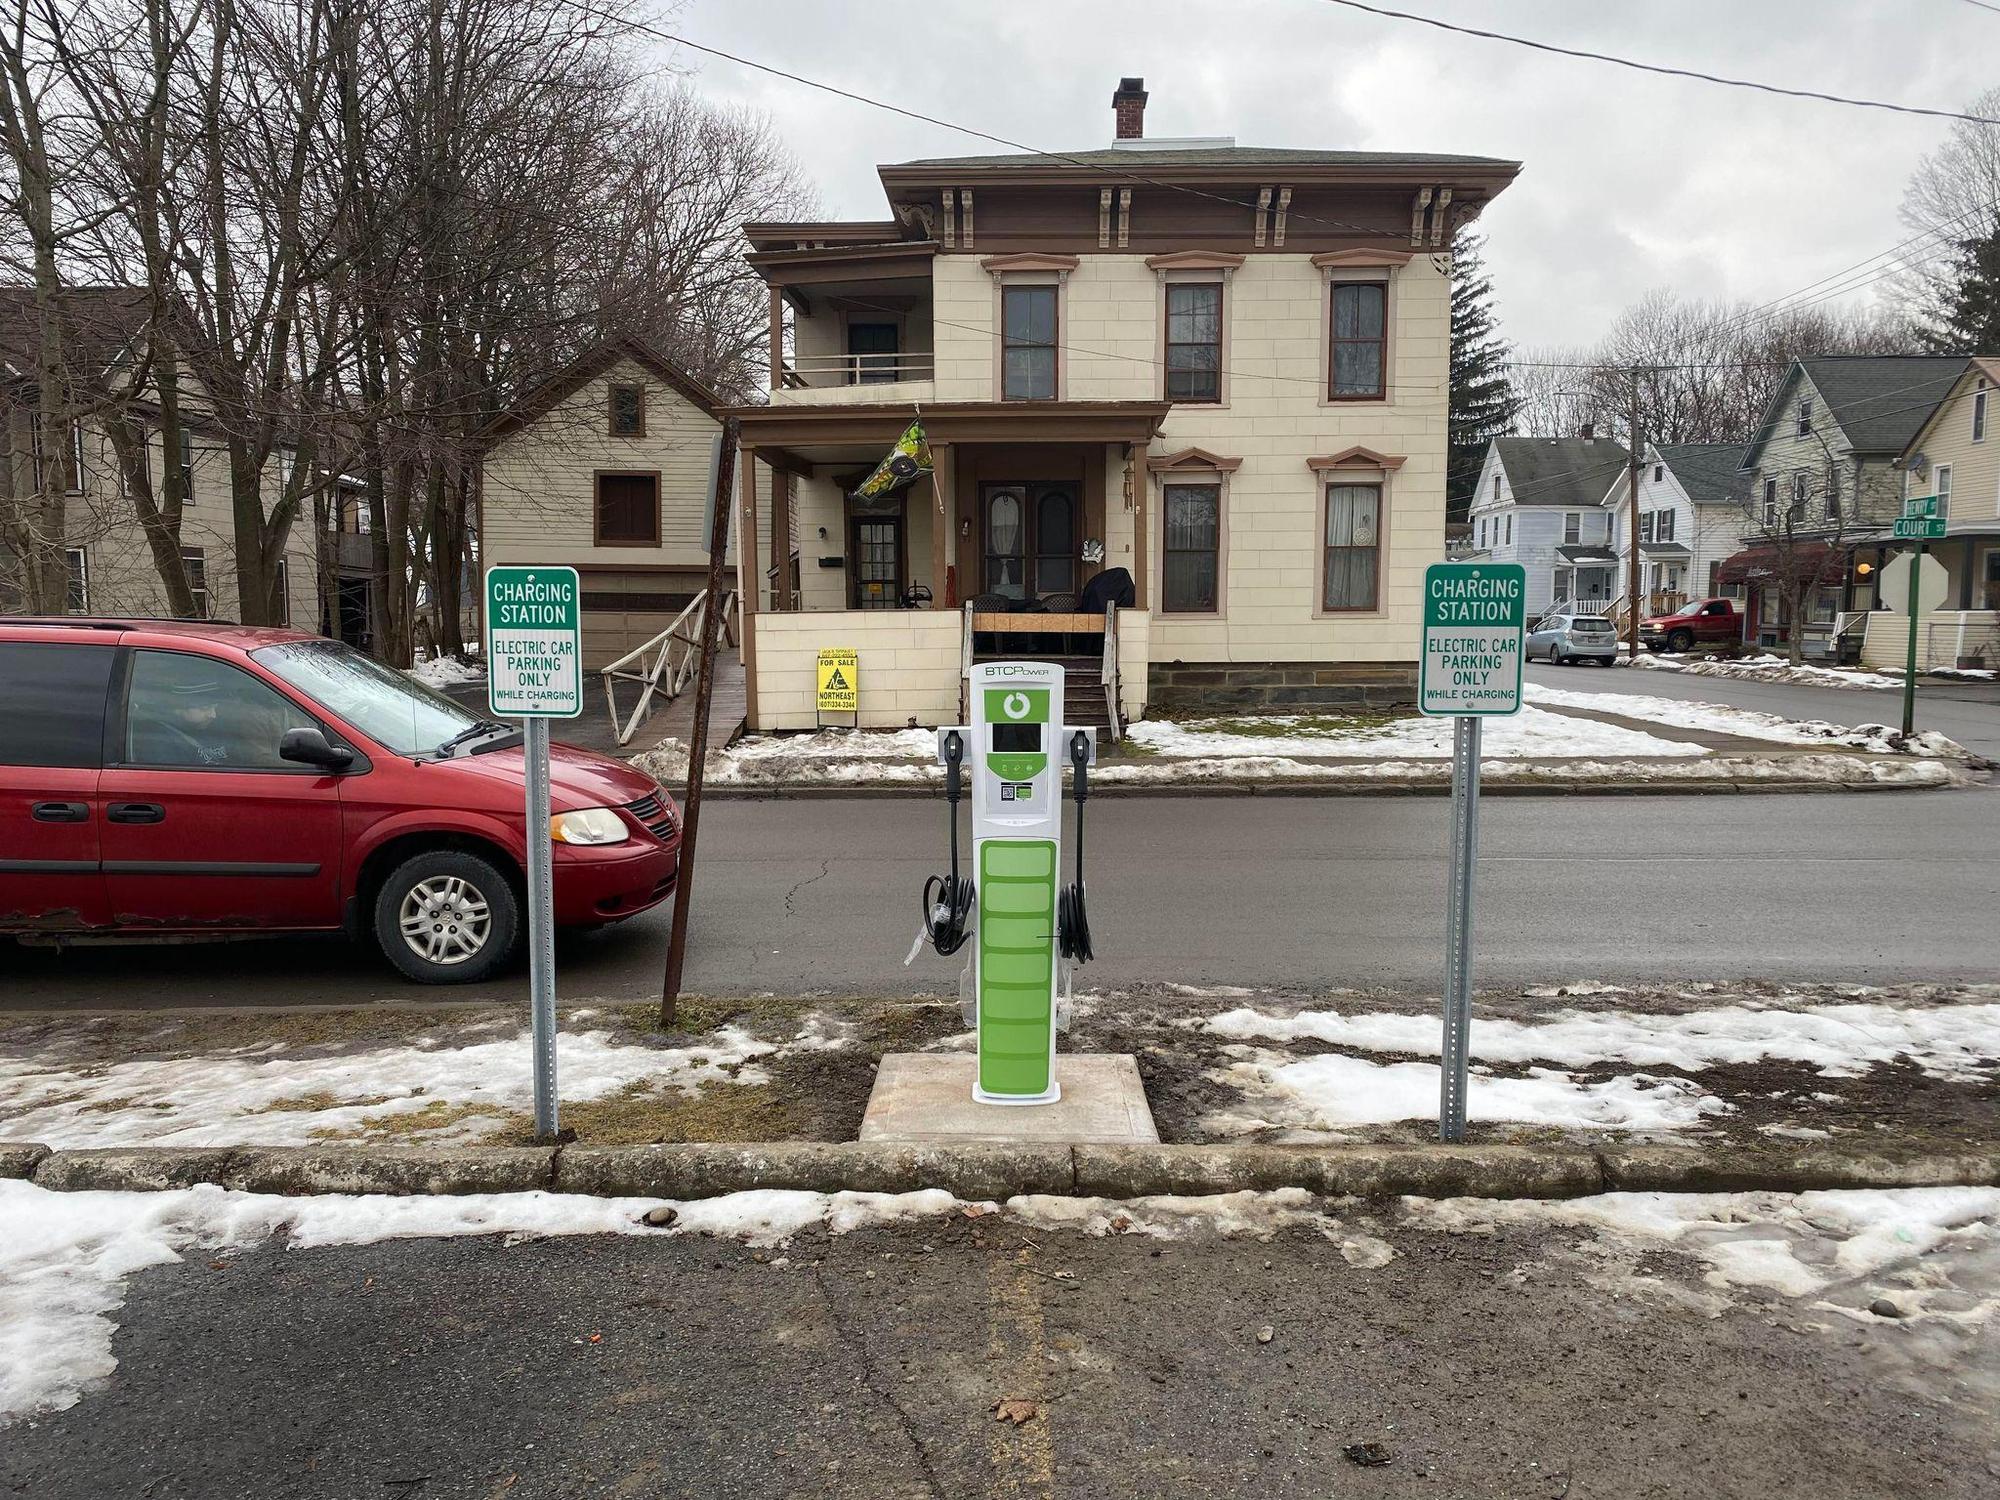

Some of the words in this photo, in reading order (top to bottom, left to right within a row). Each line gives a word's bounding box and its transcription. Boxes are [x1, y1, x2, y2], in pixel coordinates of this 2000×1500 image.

[1907, 500, 1928, 515] HENRY
[1896, 521, 1931, 535] COURT
[494, 583, 571, 602] CHARGING
[1432, 579, 1519, 598] CHARGING
[500, 605, 566, 623] STATION
[1438, 601, 1511, 620] STATION
[495, 641, 546, 655] ELECTRIC
[551, 642, 572, 655] CAR
[1429, 638, 1486, 653] ELECTRIC
[1492, 638, 1516, 653] CAR
[507, 657, 561, 671] PARKING
[1442, 655, 1502, 669] PARKING
[518, 673, 550, 686] ONLY
[1453, 671, 1490, 685] ONLY
[496, 691, 524, 700] WHILE
[527, 691, 574, 700] CHARGING
[819, 692, 855, 700] NORTHEAST
[1427, 690, 1458, 699] WHILE
[1462, 690, 1515, 699] CHARGING
